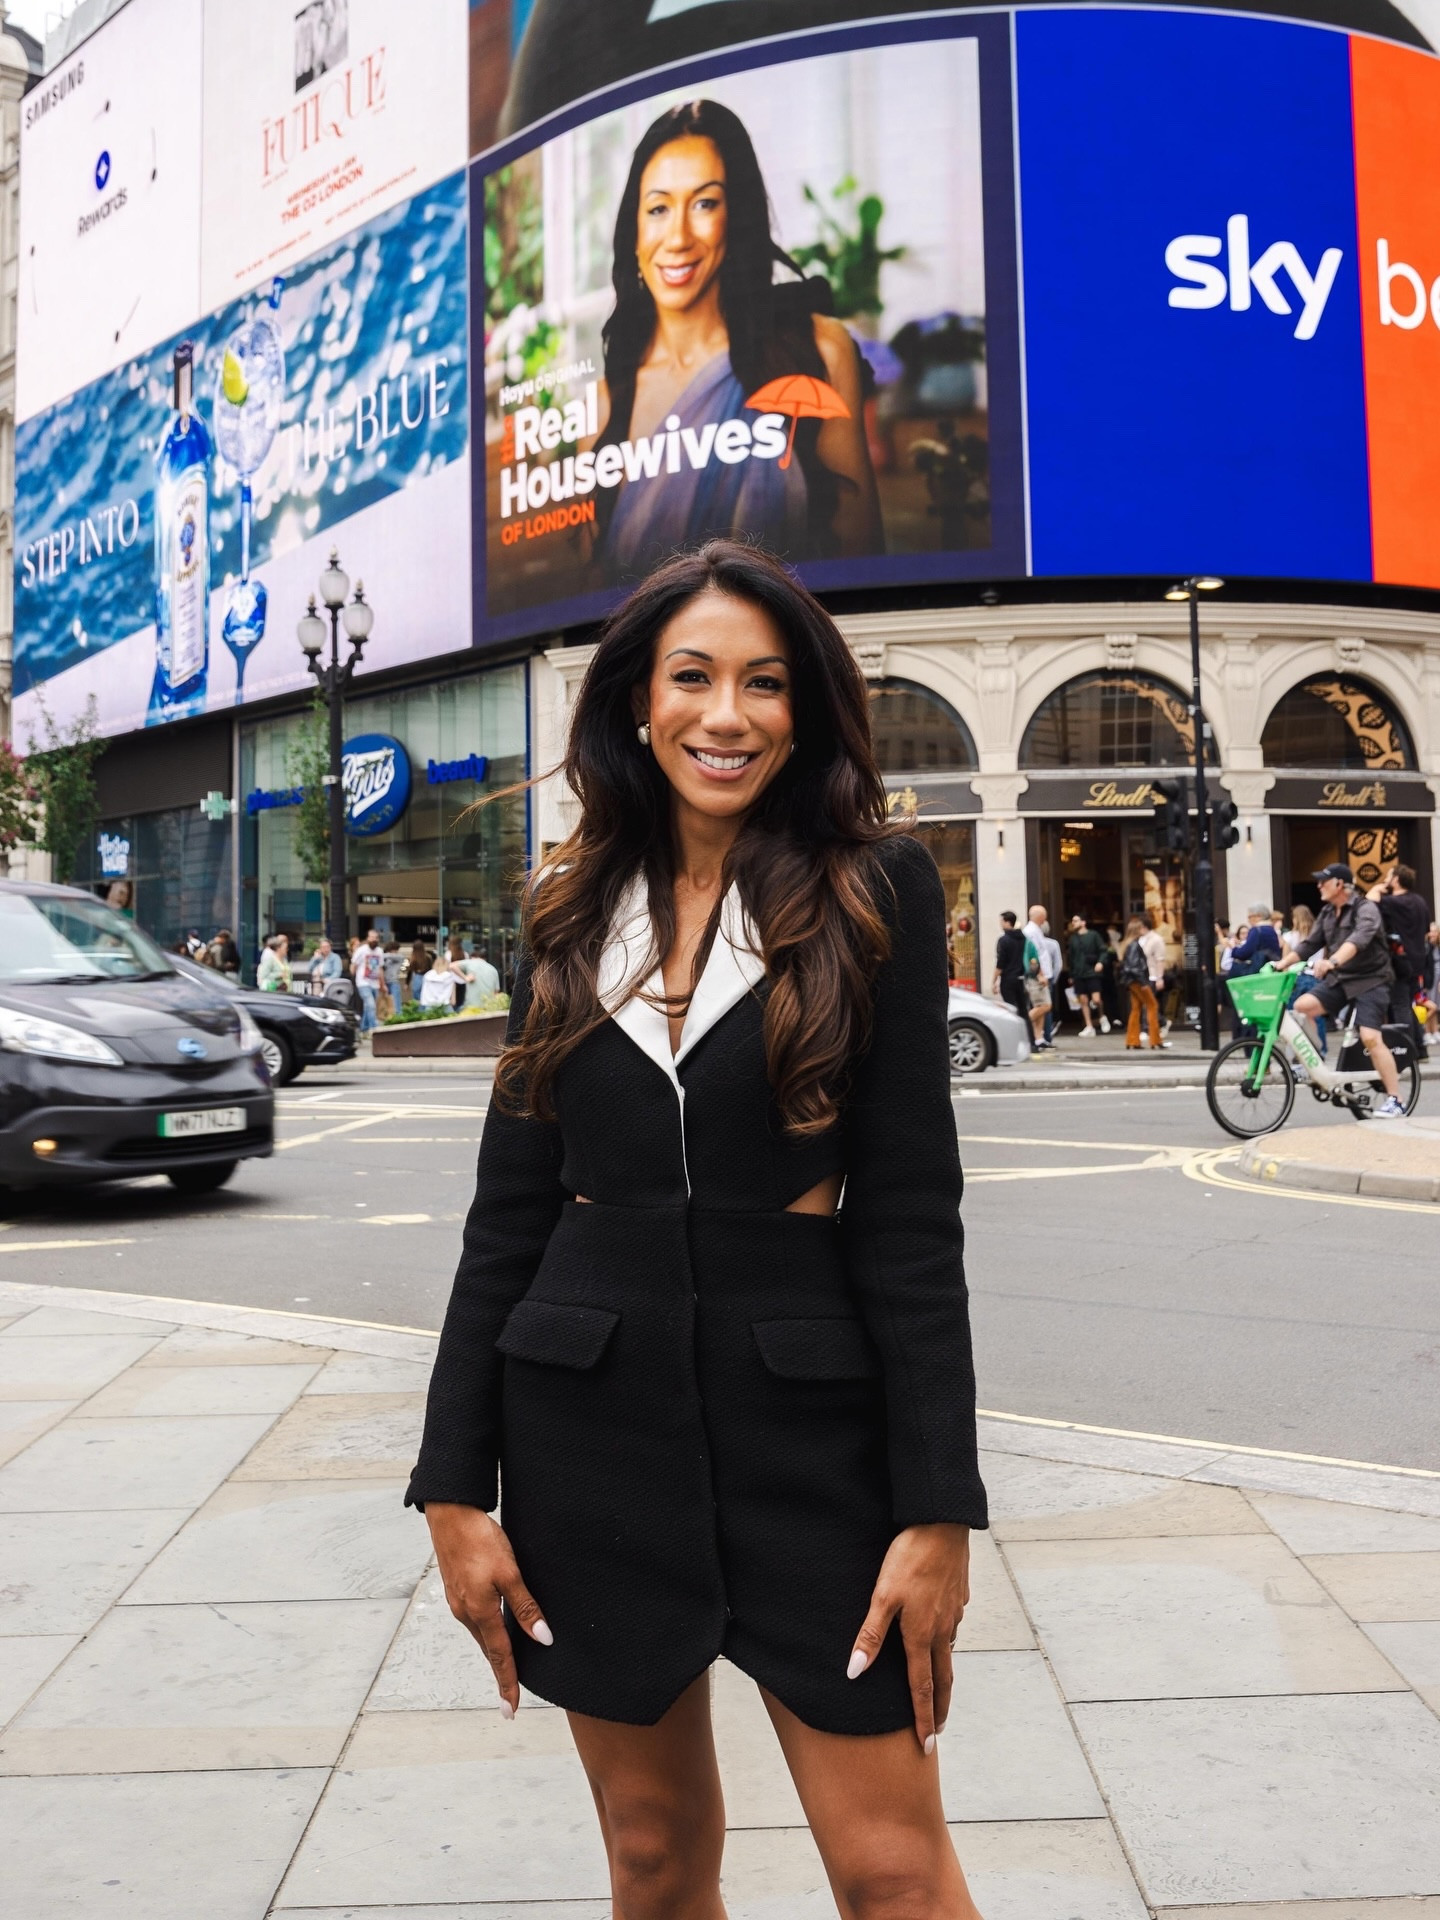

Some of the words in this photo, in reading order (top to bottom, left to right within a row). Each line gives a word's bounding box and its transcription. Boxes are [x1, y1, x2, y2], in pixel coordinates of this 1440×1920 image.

[26, 61, 85, 130] SAMSUNG
[77, 187, 128, 237] Rewards
[319, 164, 364, 202] LONDON
[1165, 213, 1343, 340] sky
[1377, 238, 1440, 331] b
[355, 357, 450, 450] BLUE
[535, 358, 596, 393] ORIGINAL
[514, 380, 598, 460] Real
[501, 413, 787, 518] Housewives
[20, 526, 75, 590] STEP
[79, 498, 140, 565] INTO
[502, 522, 524, 546] OF
[525, 500, 595, 540] LONDON
[427, 753, 488, 785] beauty
[1083, 782, 1153, 807] Lindt
[1317, 782, 1373, 806] Lindt
